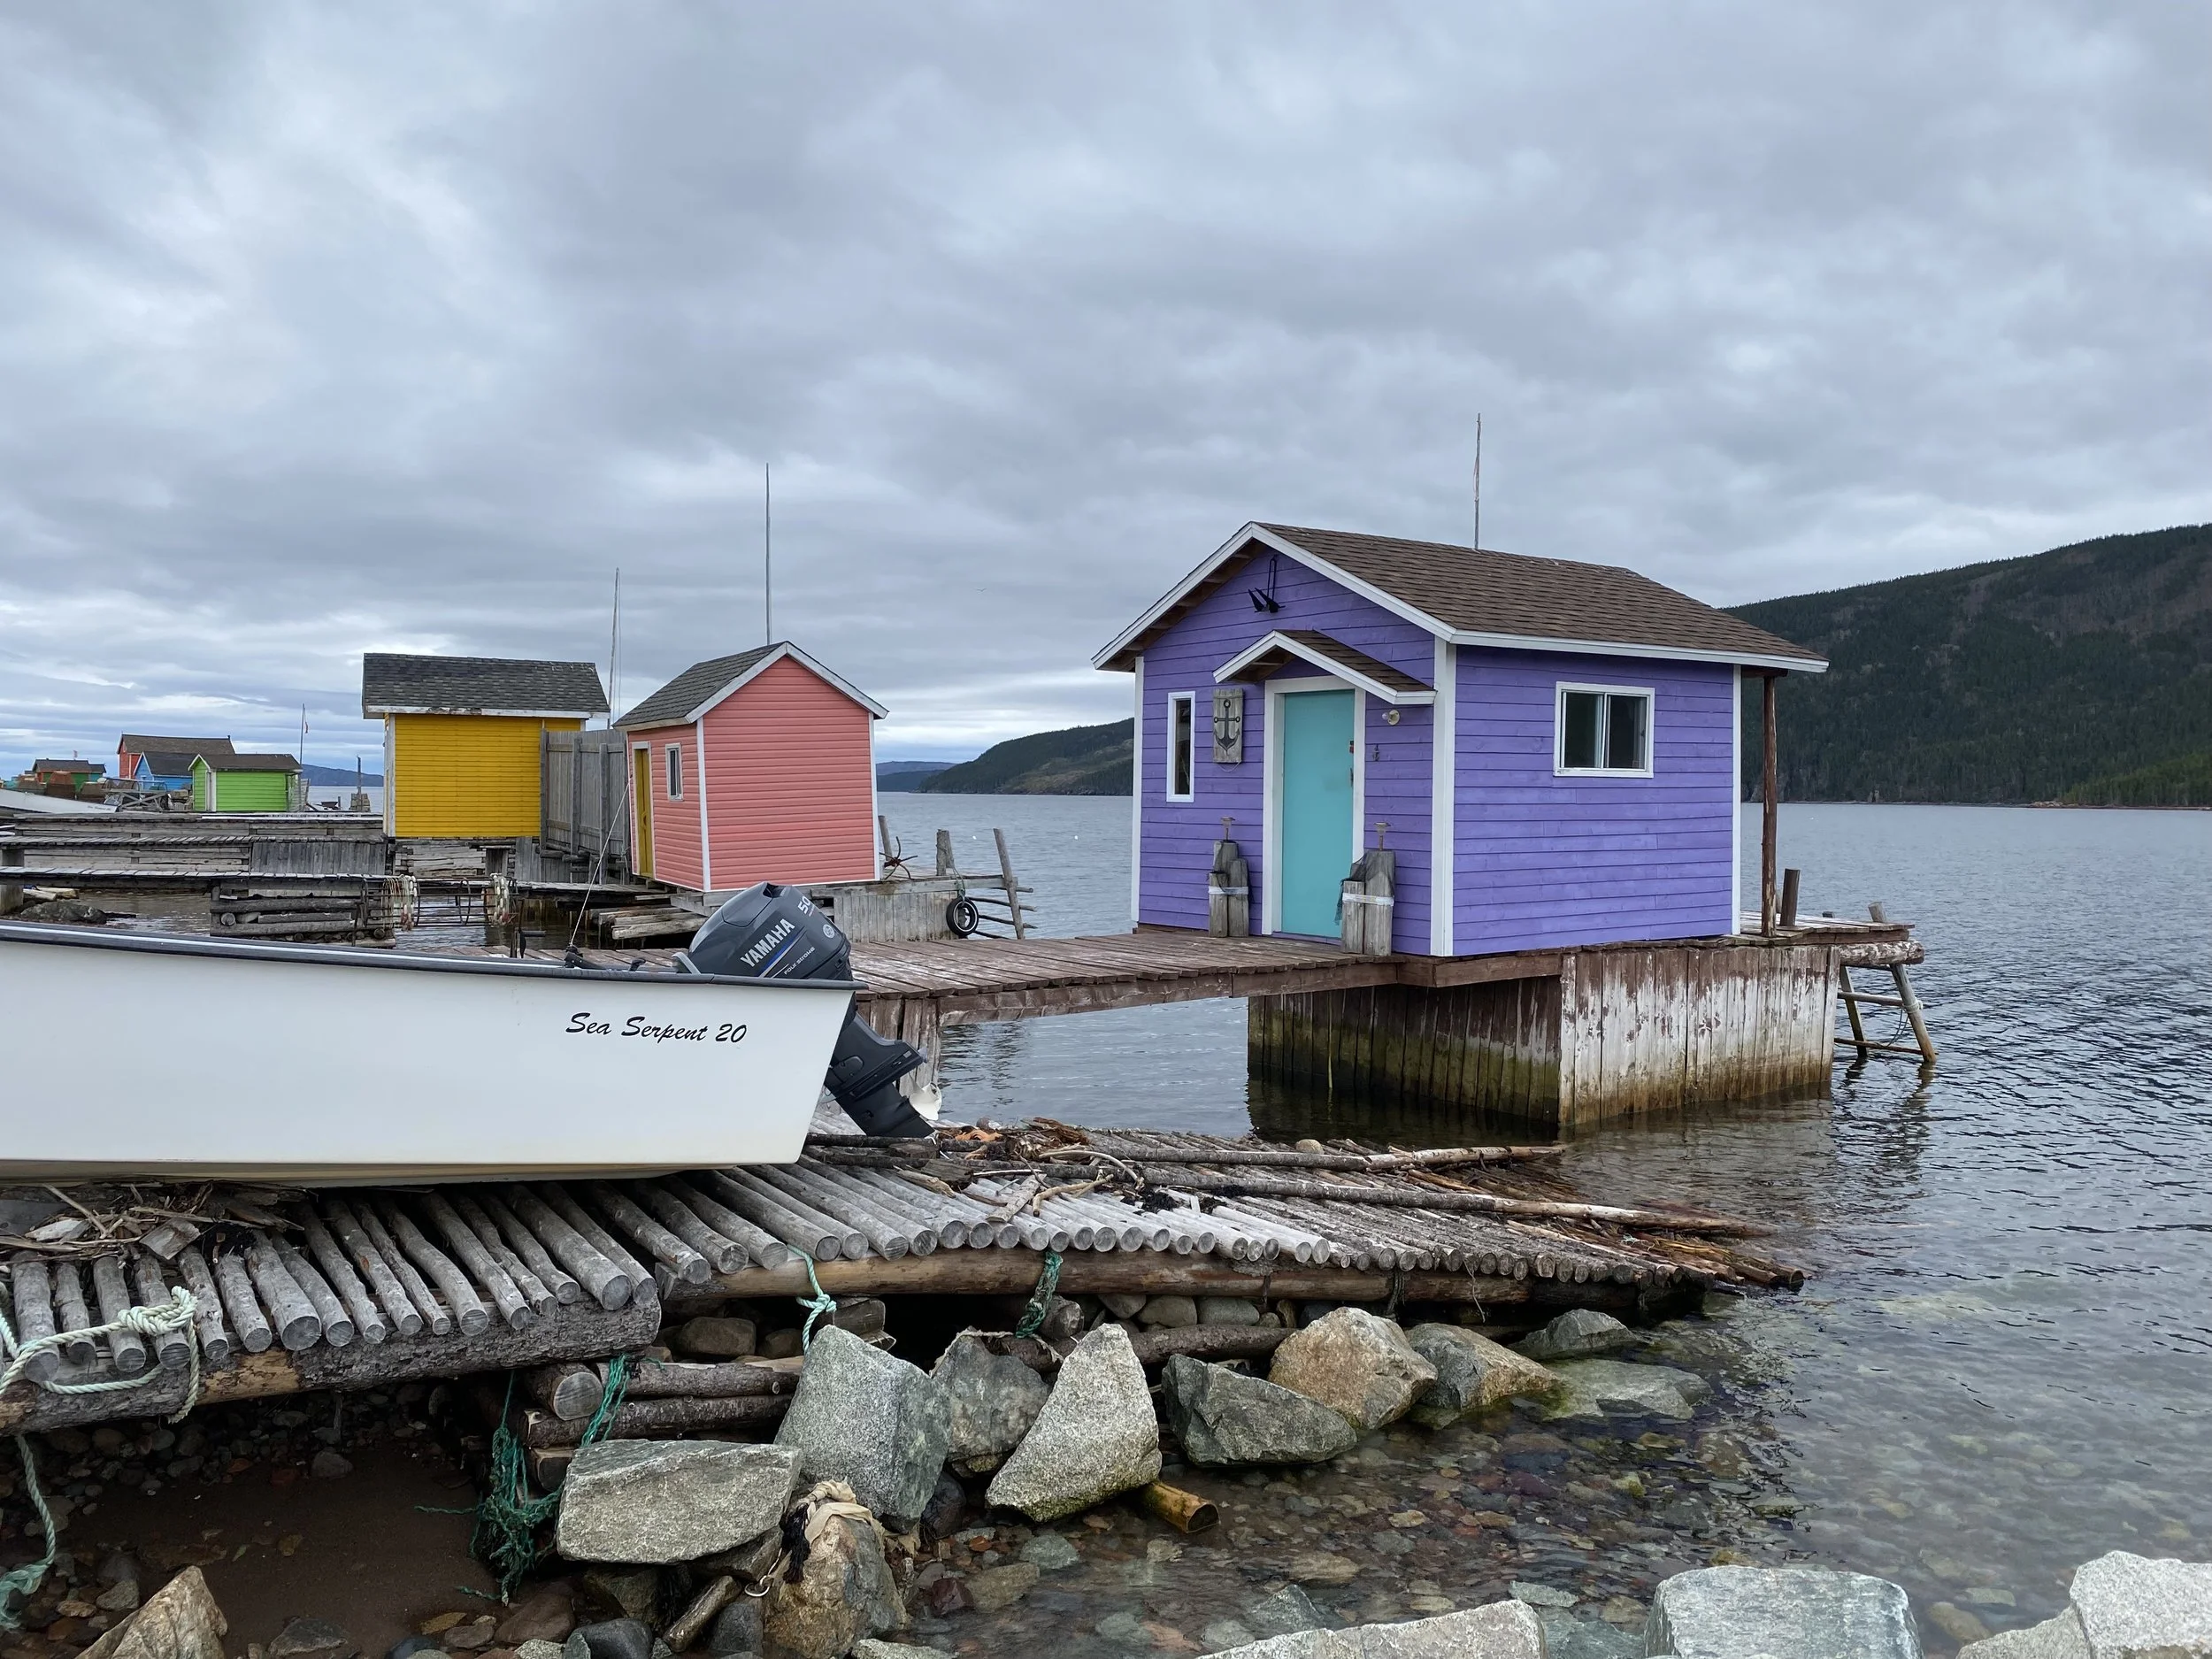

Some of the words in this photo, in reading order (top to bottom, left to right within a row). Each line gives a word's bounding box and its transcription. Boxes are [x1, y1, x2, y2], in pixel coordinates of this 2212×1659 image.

[798, 895, 811, 915] 50
[741, 918, 795, 967] YAMAHA
[565, 1012, 612, 1035] Sea
[621, 1016, 708, 1044] Serpent
[715, 1024, 747, 1043] 20
